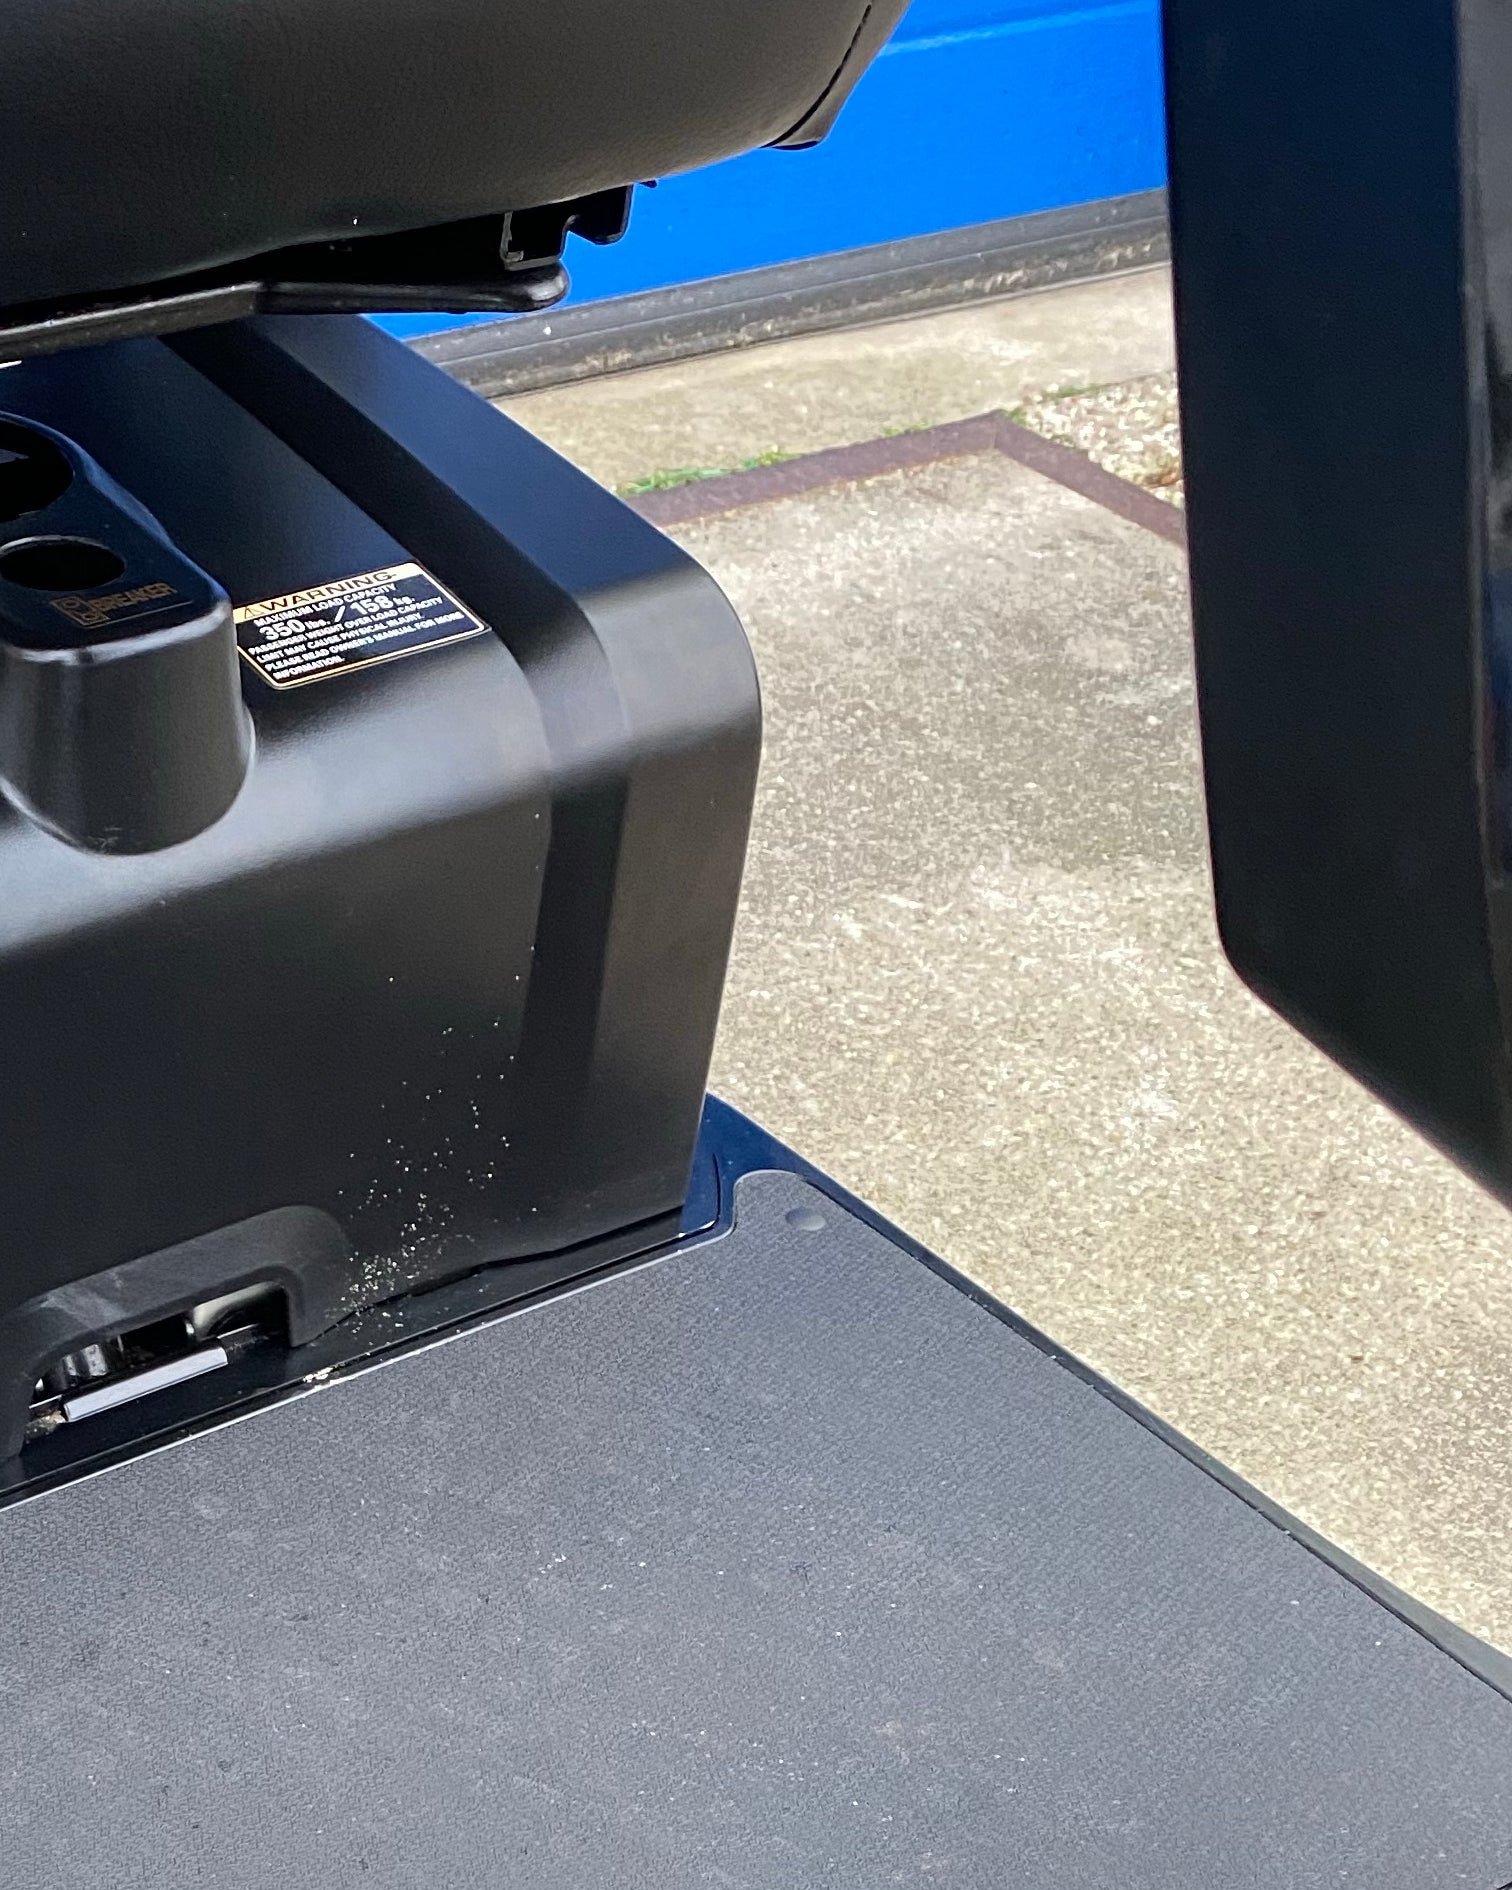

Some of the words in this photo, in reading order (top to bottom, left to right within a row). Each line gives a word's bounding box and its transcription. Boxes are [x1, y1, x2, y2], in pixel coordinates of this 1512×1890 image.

[88, 582, 178, 611] BREAKER
[253, 604, 313, 627] MAXIMUM
[313, 598, 344, 612] LOAD
[343, 583, 397, 603] CAPACITY
[259, 618, 306, 641] 350
[334, 605, 346, 623] /
[350, 595, 394, 615] 158
[248, 633, 307, 655] PASSENGER
[306, 624, 345, 638] WEIGHT
[344, 616, 373, 629] OVER
[370, 609, 399, 622] LOAD
[398, 596, 443, 614] CAPACITY
[257, 650, 284, 663] LIMIT
[284, 644, 307, 657] MAY
[306, 634, 342, 649] CAUSE
[340, 622, 388, 640] PHYSICAL
[264, 655, 304, 672] PLEASE
[302, 648, 330, 662] READ
[373, 626, 416, 641] MANUAL
[414, 618, 437, 630] FOR
[434, 611, 465, 624] MORE
